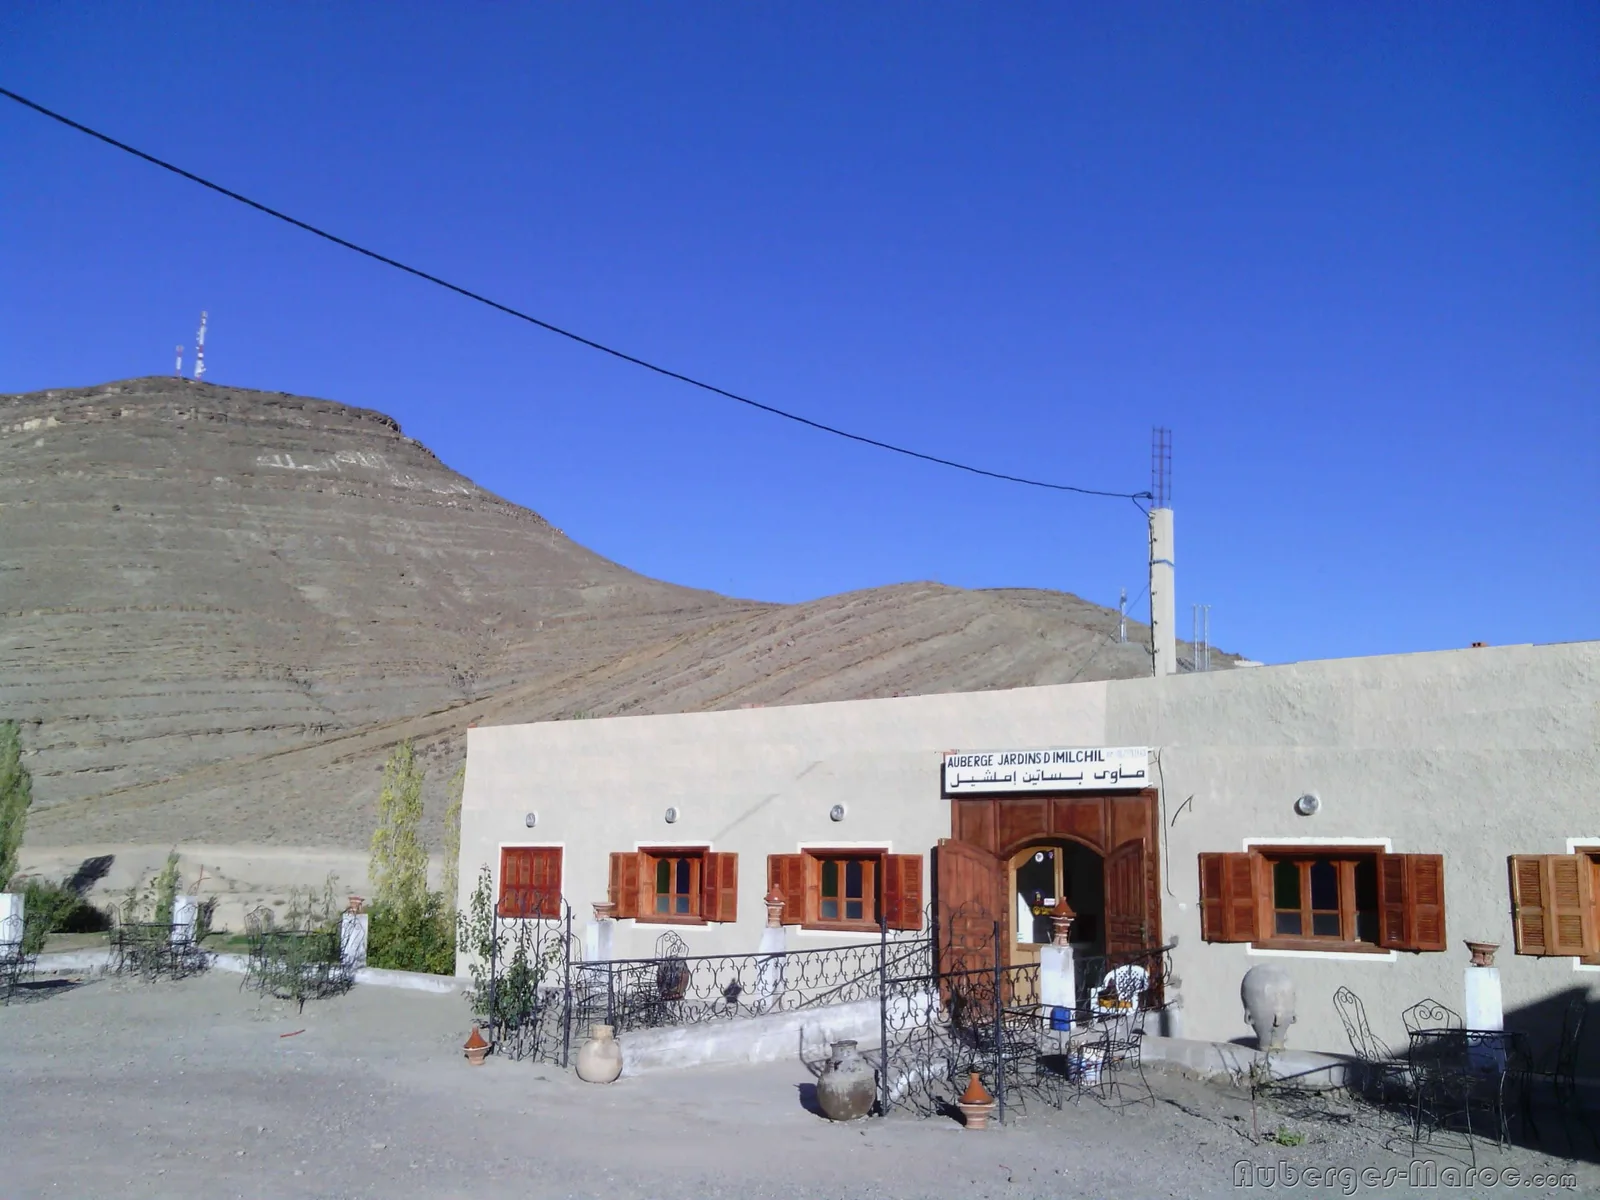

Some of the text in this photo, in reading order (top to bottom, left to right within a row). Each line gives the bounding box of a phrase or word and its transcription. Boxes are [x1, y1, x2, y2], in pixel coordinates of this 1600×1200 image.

[947, 754, 994, 768] AUBERGE
[998, 752, 1042, 765] JARDINS
[1022, 769, 1083, 786] بساتين
